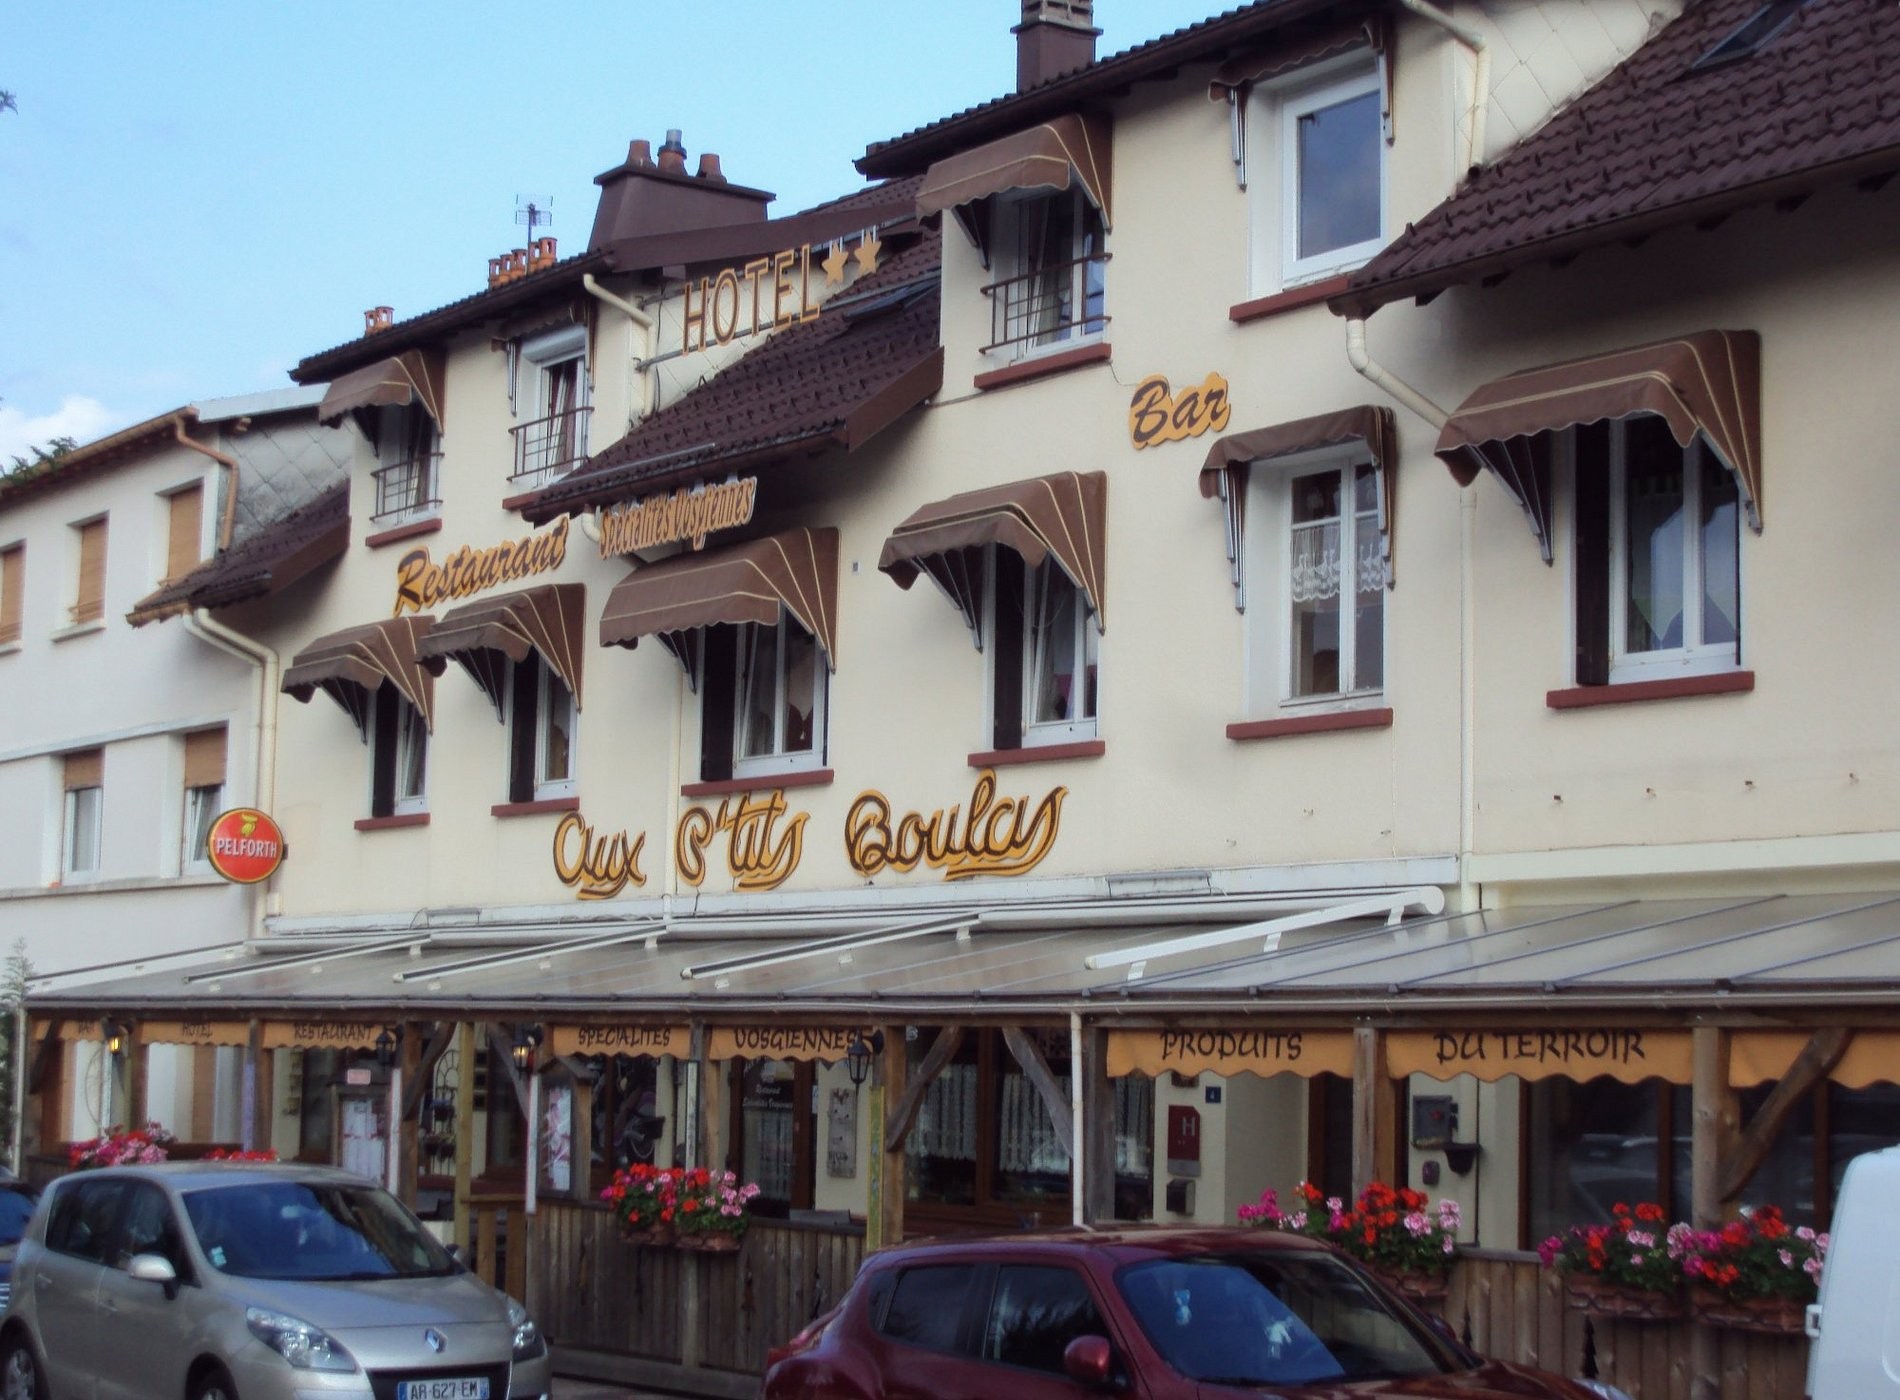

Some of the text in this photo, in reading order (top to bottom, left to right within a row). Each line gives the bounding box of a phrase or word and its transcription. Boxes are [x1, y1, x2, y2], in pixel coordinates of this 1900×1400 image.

[682, 243, 822, 357] HOTEL
[1129, 371, 1231, 450] Bar
[393, 515, 569, 618] Restaurant
[217, 838, 278, 857] PELFORTH
[553, 810, 647, 900] Aux
[675, 788, 810, 892] P'tits
[182, 1022, 214, 1038] HOTEL
[294, 1022, 373, 1043] RESTAURANT
[1160, 1028, 1646, 1065] PRODUITS DU TERROIR
[1181, 1116, 1196, 1137] H
